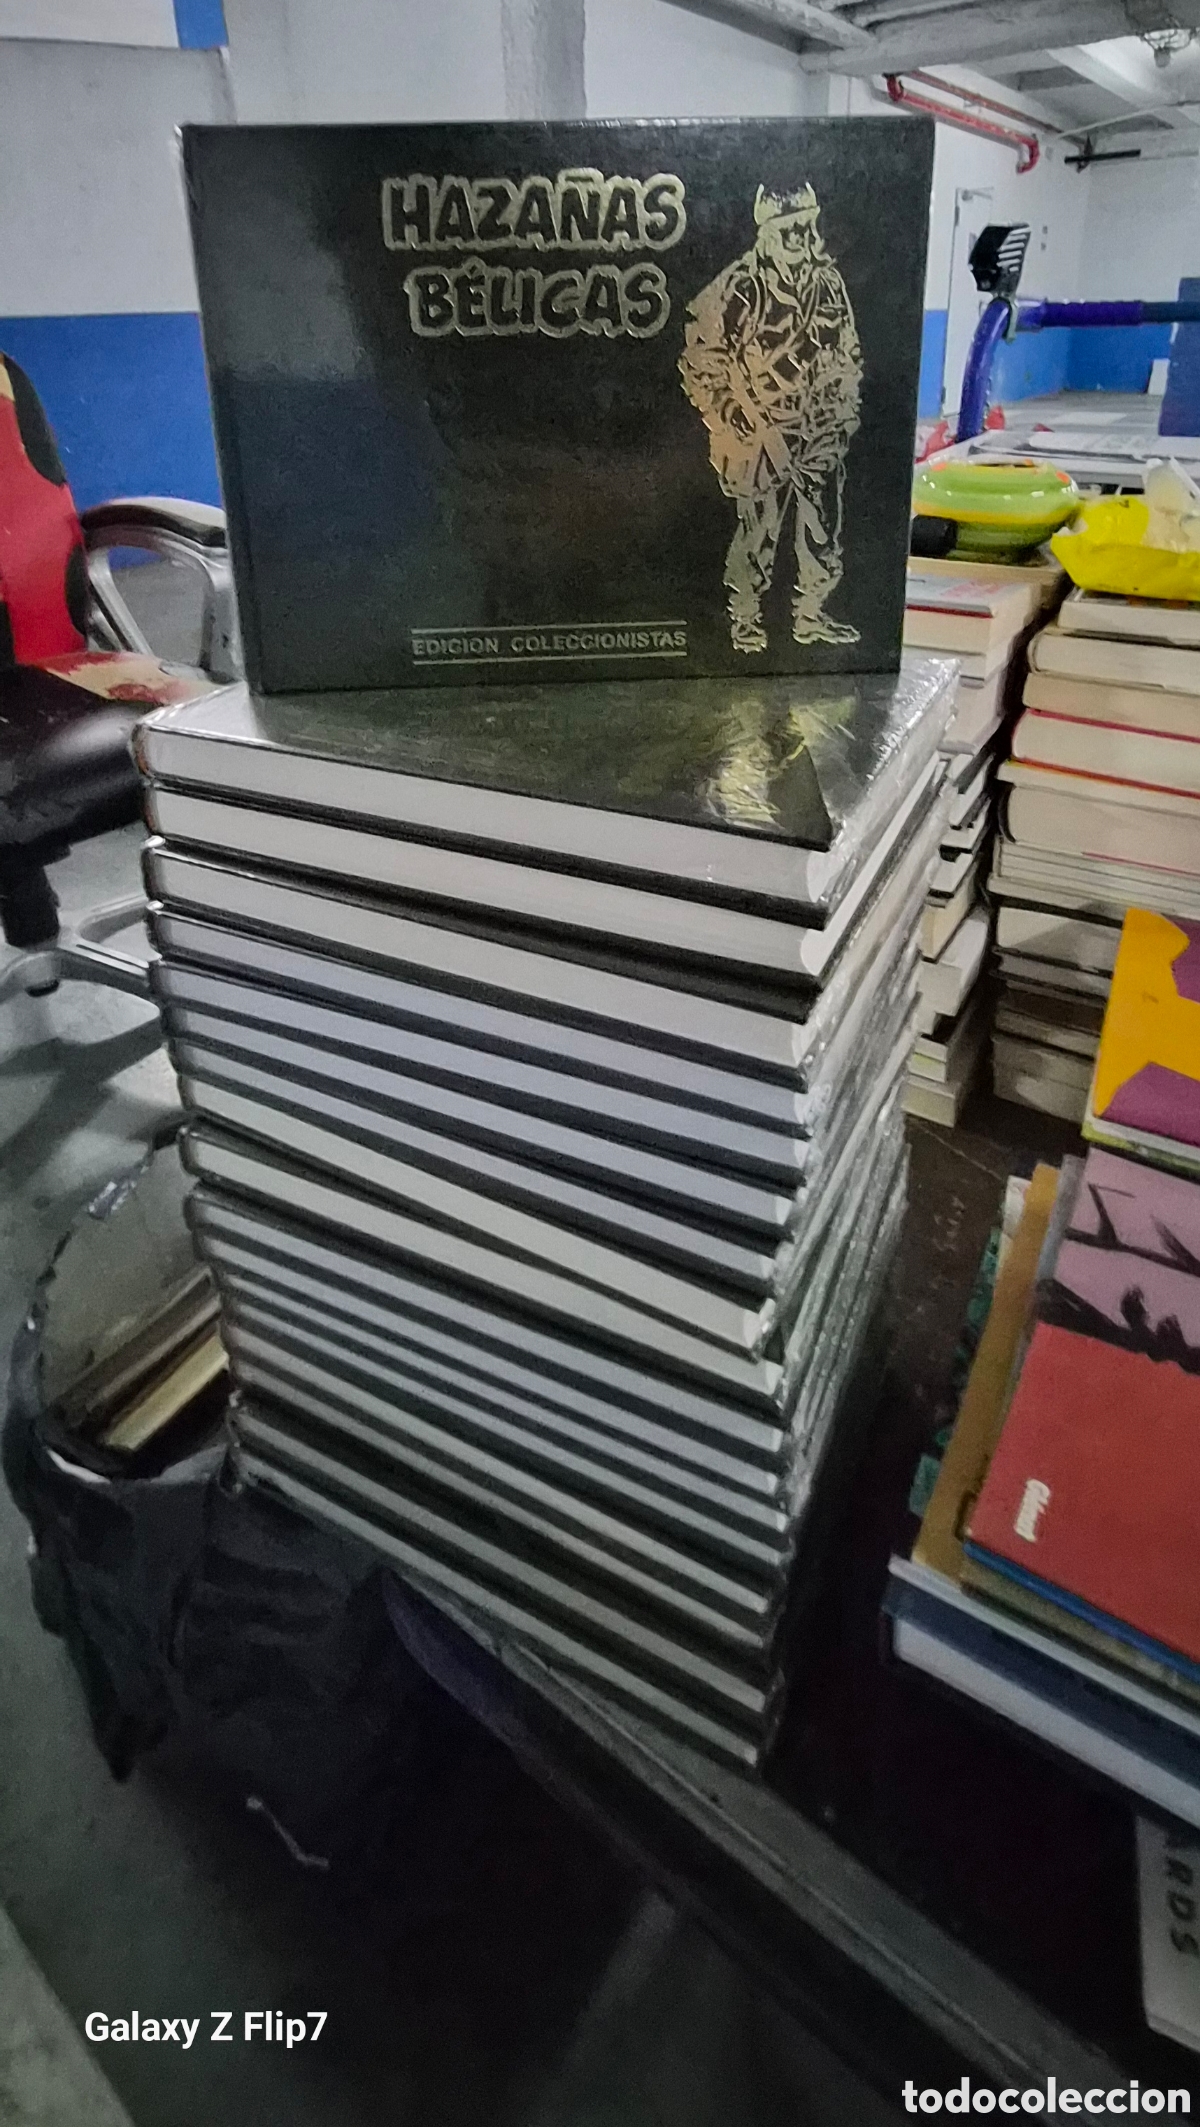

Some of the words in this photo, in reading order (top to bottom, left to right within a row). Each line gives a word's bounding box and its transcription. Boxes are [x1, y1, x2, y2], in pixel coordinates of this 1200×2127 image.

[381, 167, 687, 251] HAZAÑAS
[403, 256, 671, 338] BÉLICAS
[411, 638, 499, 656] EDICION
[510, 631, 687, 652] COLECCIONISTAS
[1164, 1843, 1200, 1958] RDS
